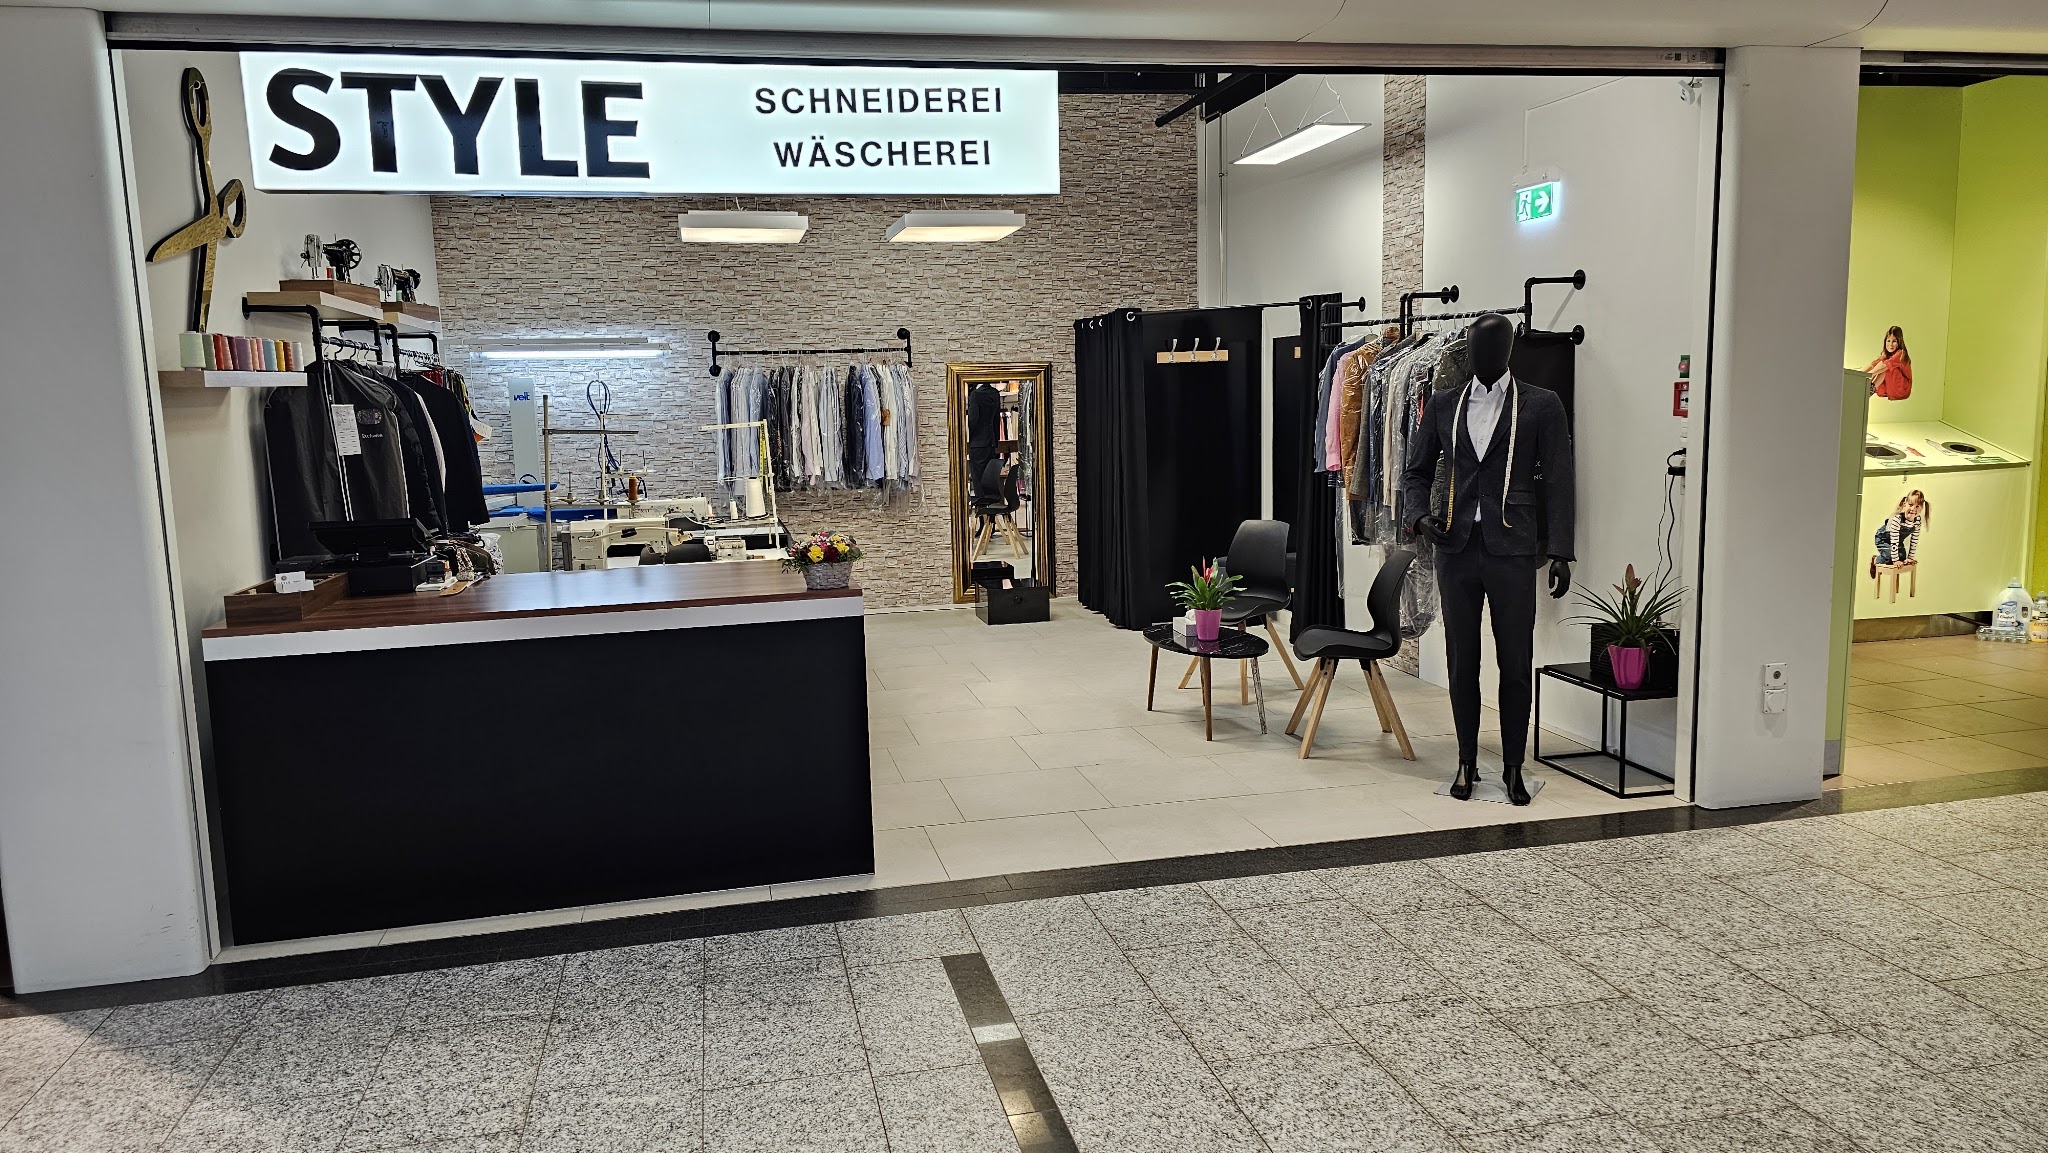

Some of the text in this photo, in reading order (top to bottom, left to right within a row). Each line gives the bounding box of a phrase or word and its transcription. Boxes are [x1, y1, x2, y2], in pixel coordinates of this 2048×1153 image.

[755, 87, 1003, 114] SCHNEIDEREI
[266, 67, 650, 178] STYLE
[773, 136, 991, 167] WÄSCHEREI
